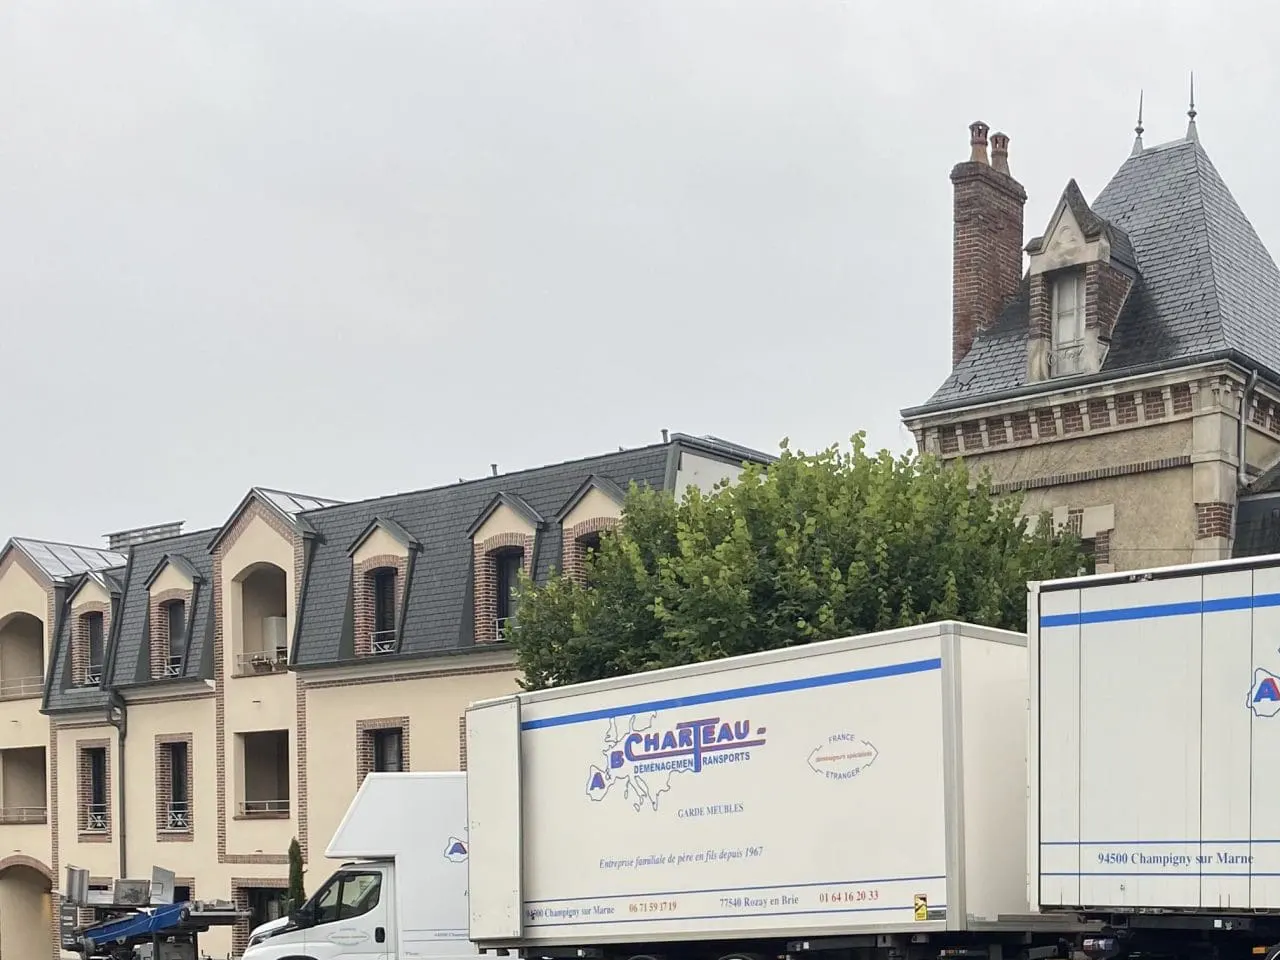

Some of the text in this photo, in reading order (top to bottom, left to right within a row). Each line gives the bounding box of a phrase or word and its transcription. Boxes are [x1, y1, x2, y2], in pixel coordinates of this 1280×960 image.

[828, 733, 855, 744] FRANCE
[825, 767, 861, 780] ETRANGER
[677, 801, 744, 818] GARDE MEUBLES
[1098, 851, 1255, 867] 94500 Champigny sur Marne
[819, 890, 879, 903] 01 64 16 20 33
[628, 902, 638, 913] 06
[639, 902, 648, 913] 71
[649, 902, 659, 912] 59
